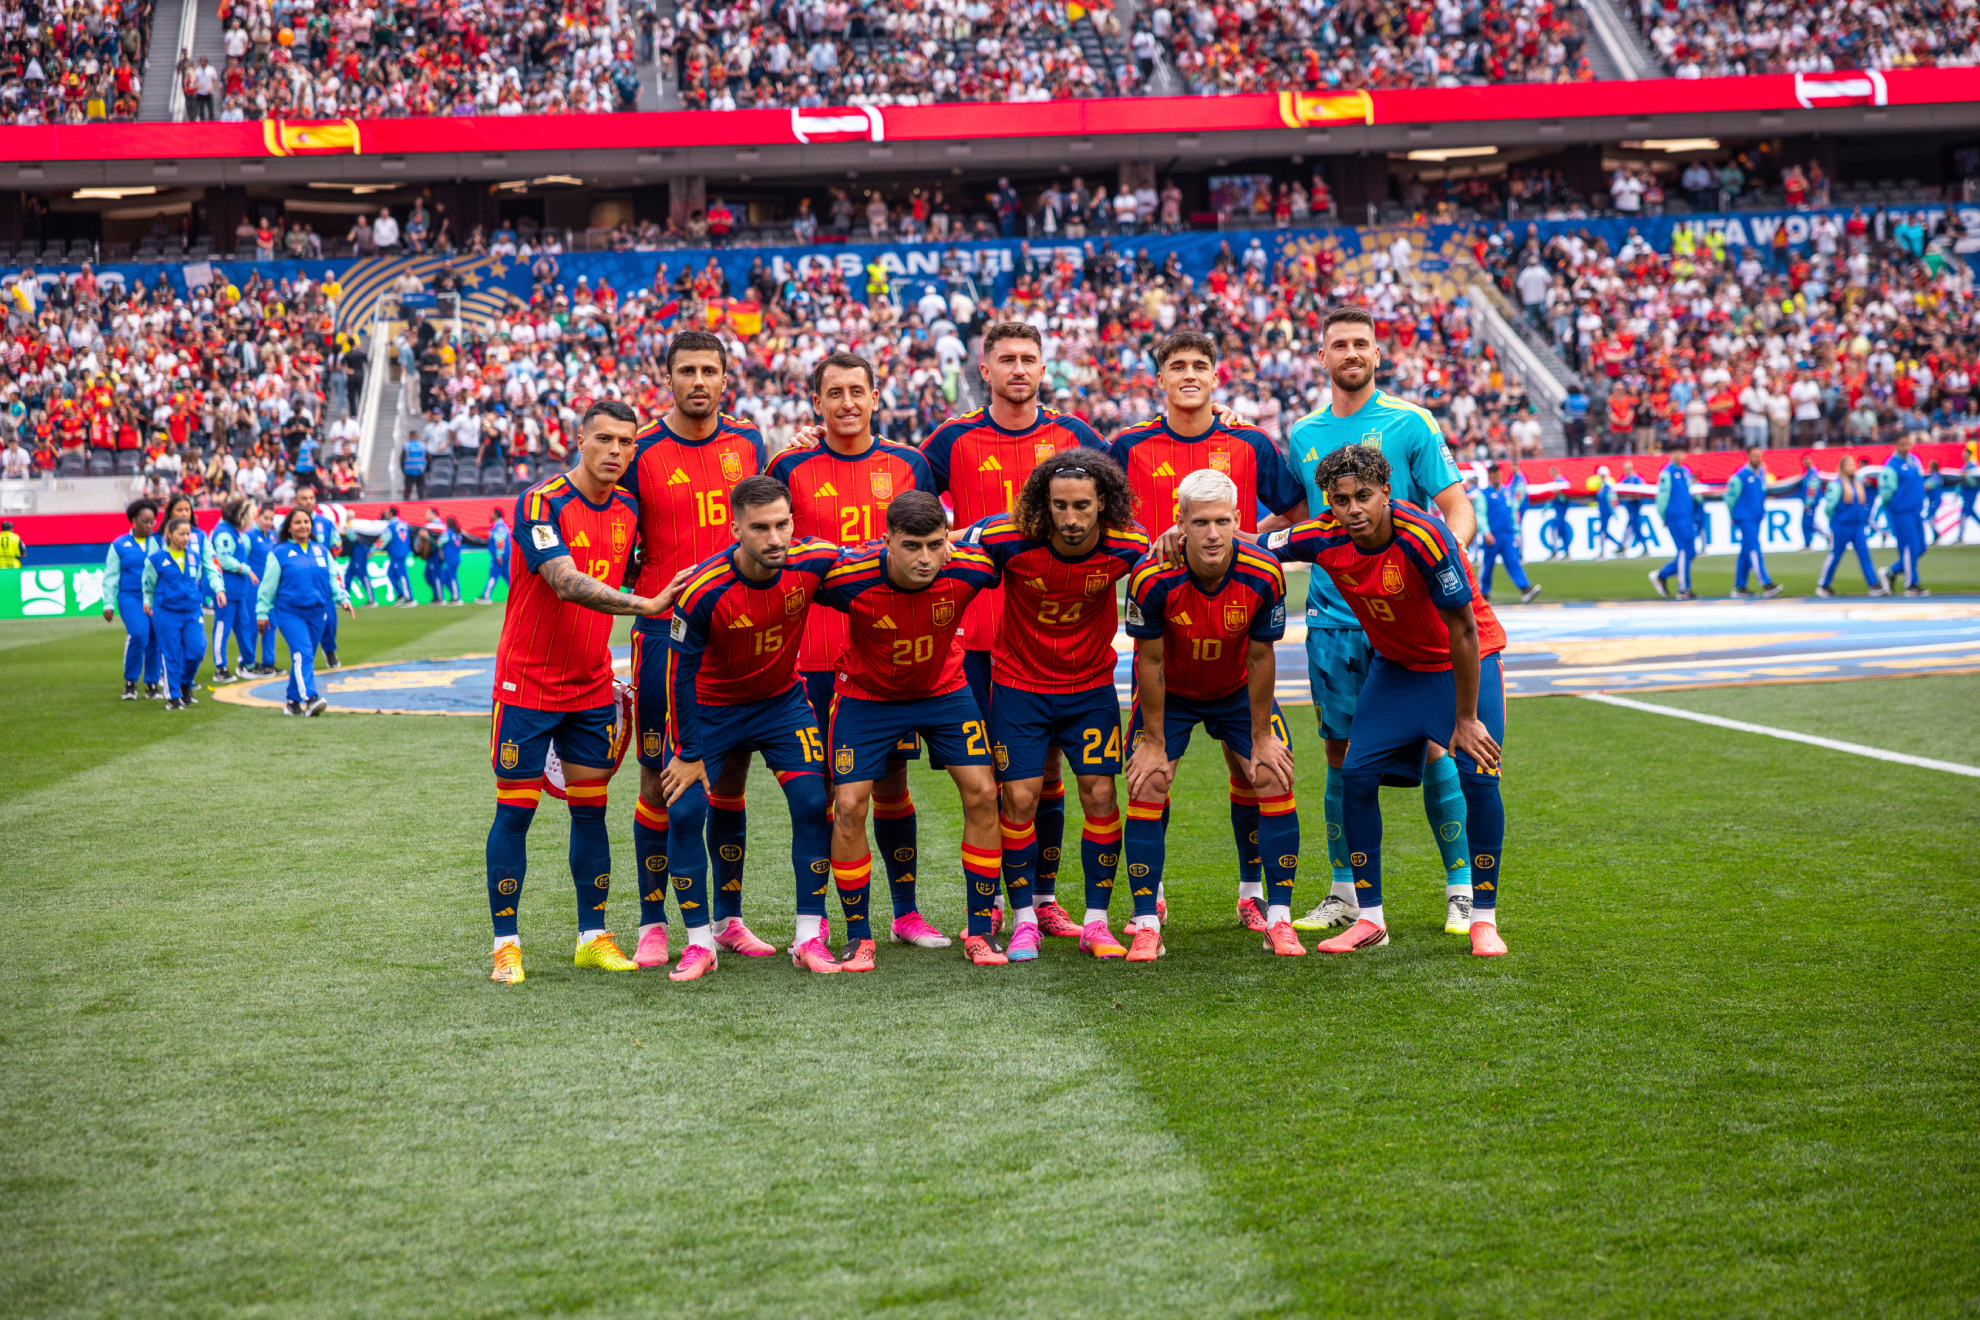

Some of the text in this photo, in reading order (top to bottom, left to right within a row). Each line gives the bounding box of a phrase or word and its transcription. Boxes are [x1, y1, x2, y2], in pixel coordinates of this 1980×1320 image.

[696, 490, 727, 528] 16
[841, 505, 871, 542] 21
[1038, 601, 1083, 625] 24
[1360, 596, 1395, 622] 19
[755, 624, 783, 656] 15
[893, 634, 933, 665] 20
[1191, 638, 1222, 661] 10
[795, 726, 825, 763] 15
[1082, 725, 1121, 764] 24
